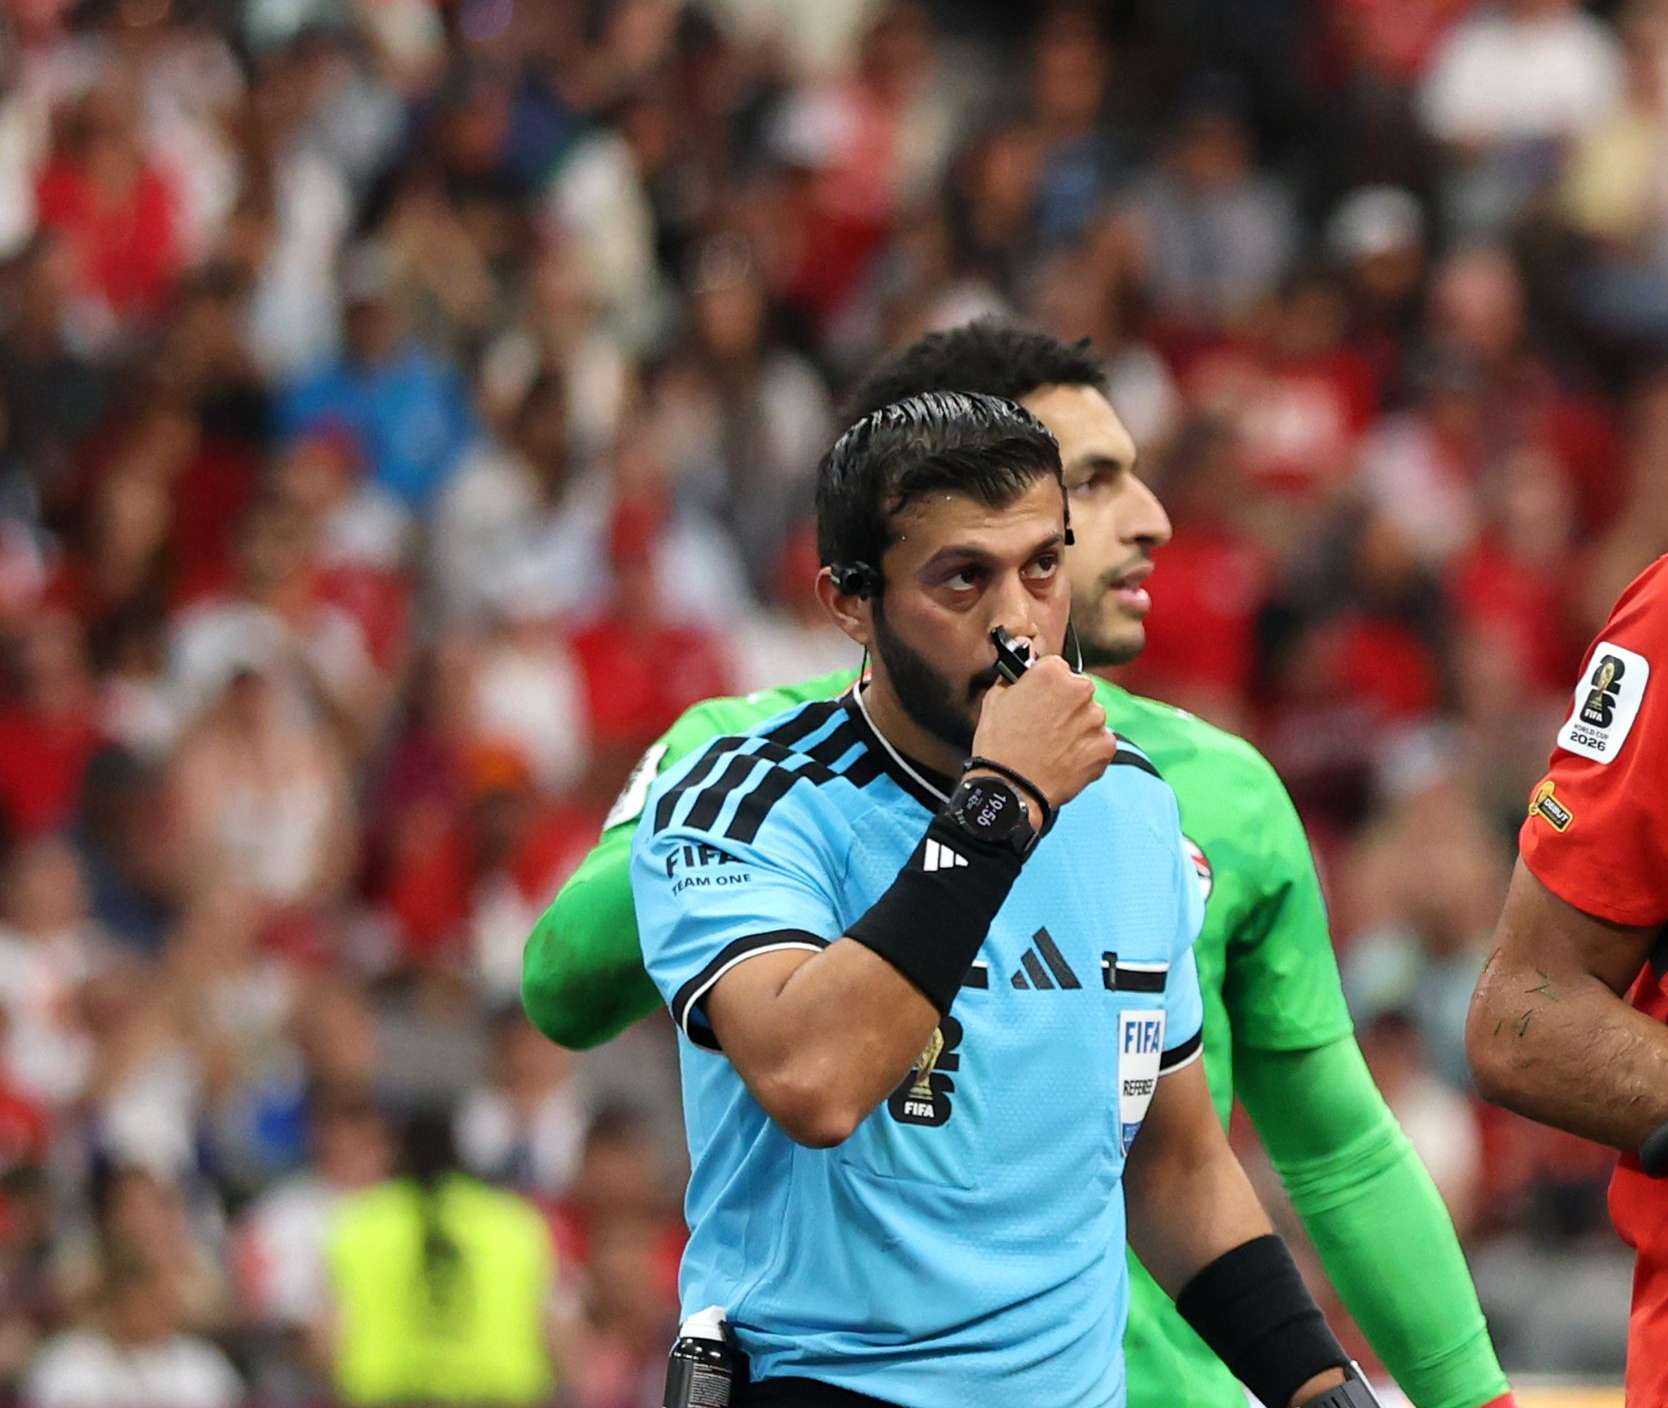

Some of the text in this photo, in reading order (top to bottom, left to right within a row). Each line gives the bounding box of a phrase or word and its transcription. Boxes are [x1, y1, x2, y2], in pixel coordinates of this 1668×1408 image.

[1569, 731, 1606, 752] 2026
[976, 792, 1008, 827] 19:56
[671, 873, 752, 897] TEAM ONE
[1125, 1021, 1161, 1054] FIFA
[903, 1100, 935, 1118] FIFA
